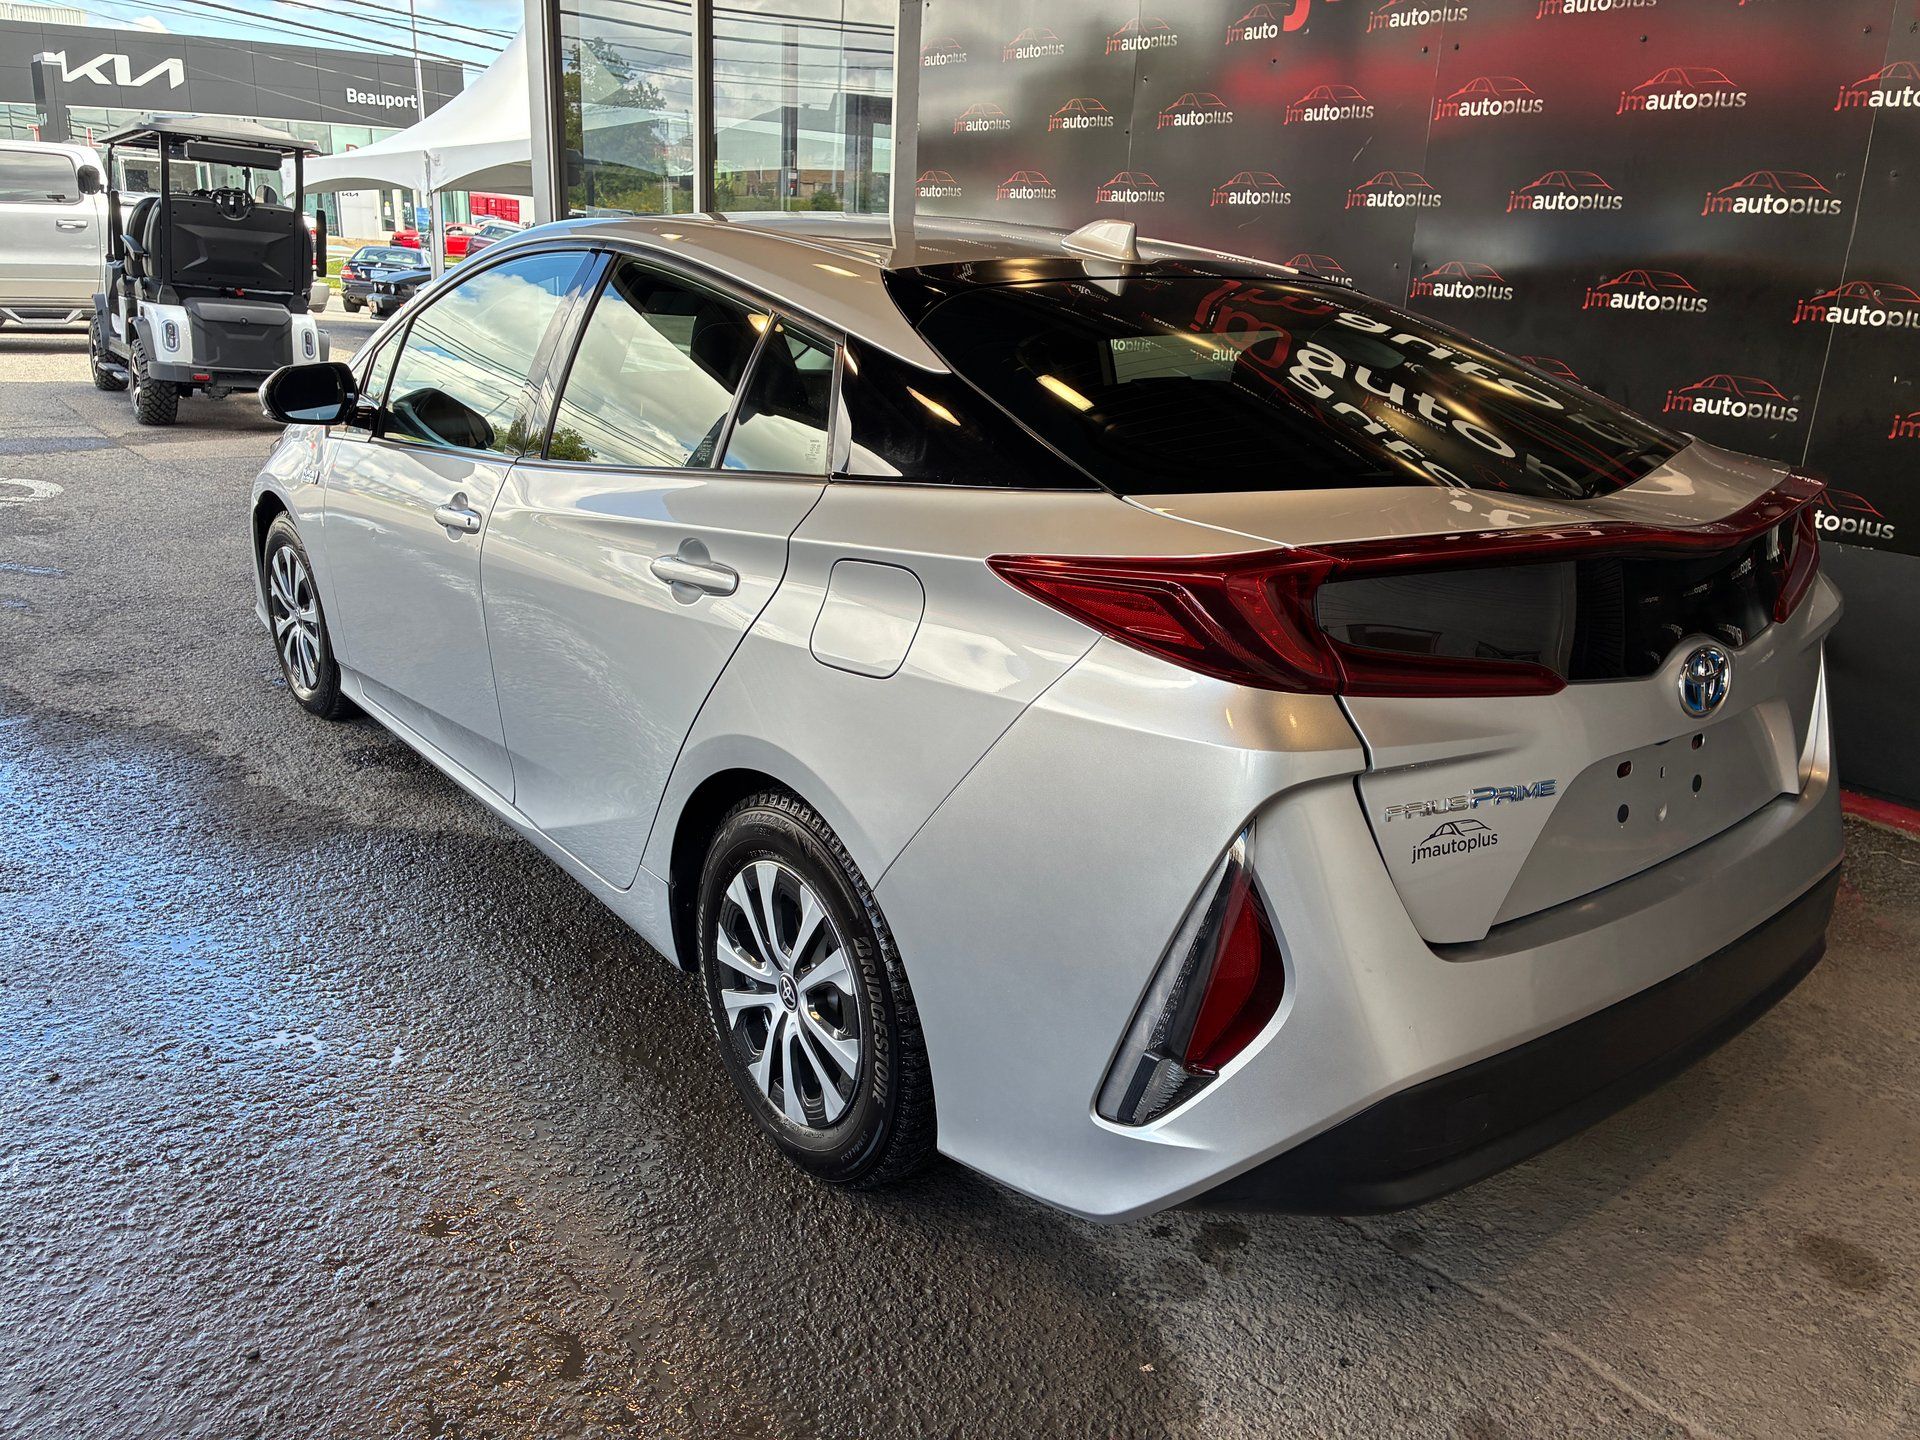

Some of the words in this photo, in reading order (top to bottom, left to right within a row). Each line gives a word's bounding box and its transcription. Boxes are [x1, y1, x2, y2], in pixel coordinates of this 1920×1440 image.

[1366, 5, 1468, 33] jmautoplus
[1104, 31, 1178, 56] jmautoplus
[1225, 22, 1279, 45] jmauto
[1002, 42, 1065, 63] jmautoplus
[51, 50, 185, 90] KIA
[346, 88, 418, 110] Beauport
[1434, 97, 1544, 121] jmautoplus
[1616, 90, 1748, 116] jmautoplus
[953, 117, 1012, 135] jmautoplus
[1047, 113, 1114, 133] jmautoplus
[1156, 109, 1234, 129] jmautoplus
[1284, 104, 1375, 126] jmautoplus
[995, 184, 1057, 201] jmautoplus
[1095, 186, 1166, 204] jmautoplus
[1209, 187, 1293, 208] jmautoplus
[1345, 189, 1442, 210] jmautoplus
[1506, 190, 1623, 213] jmautoplus
[1702, 191, 1842, 217] jmautoplus
[1410, 278, 1514, 301] jmautoplus
[1581, 287, 1708, 313] jmautoplus
[1662, 390, 1799, 422] jmautoplus
[1814, 508, 1896, 540] toplus
[1411, 832, 1499, 865] jmautoplus
[853, 935, 889, 1108] BRIDGESTONE
